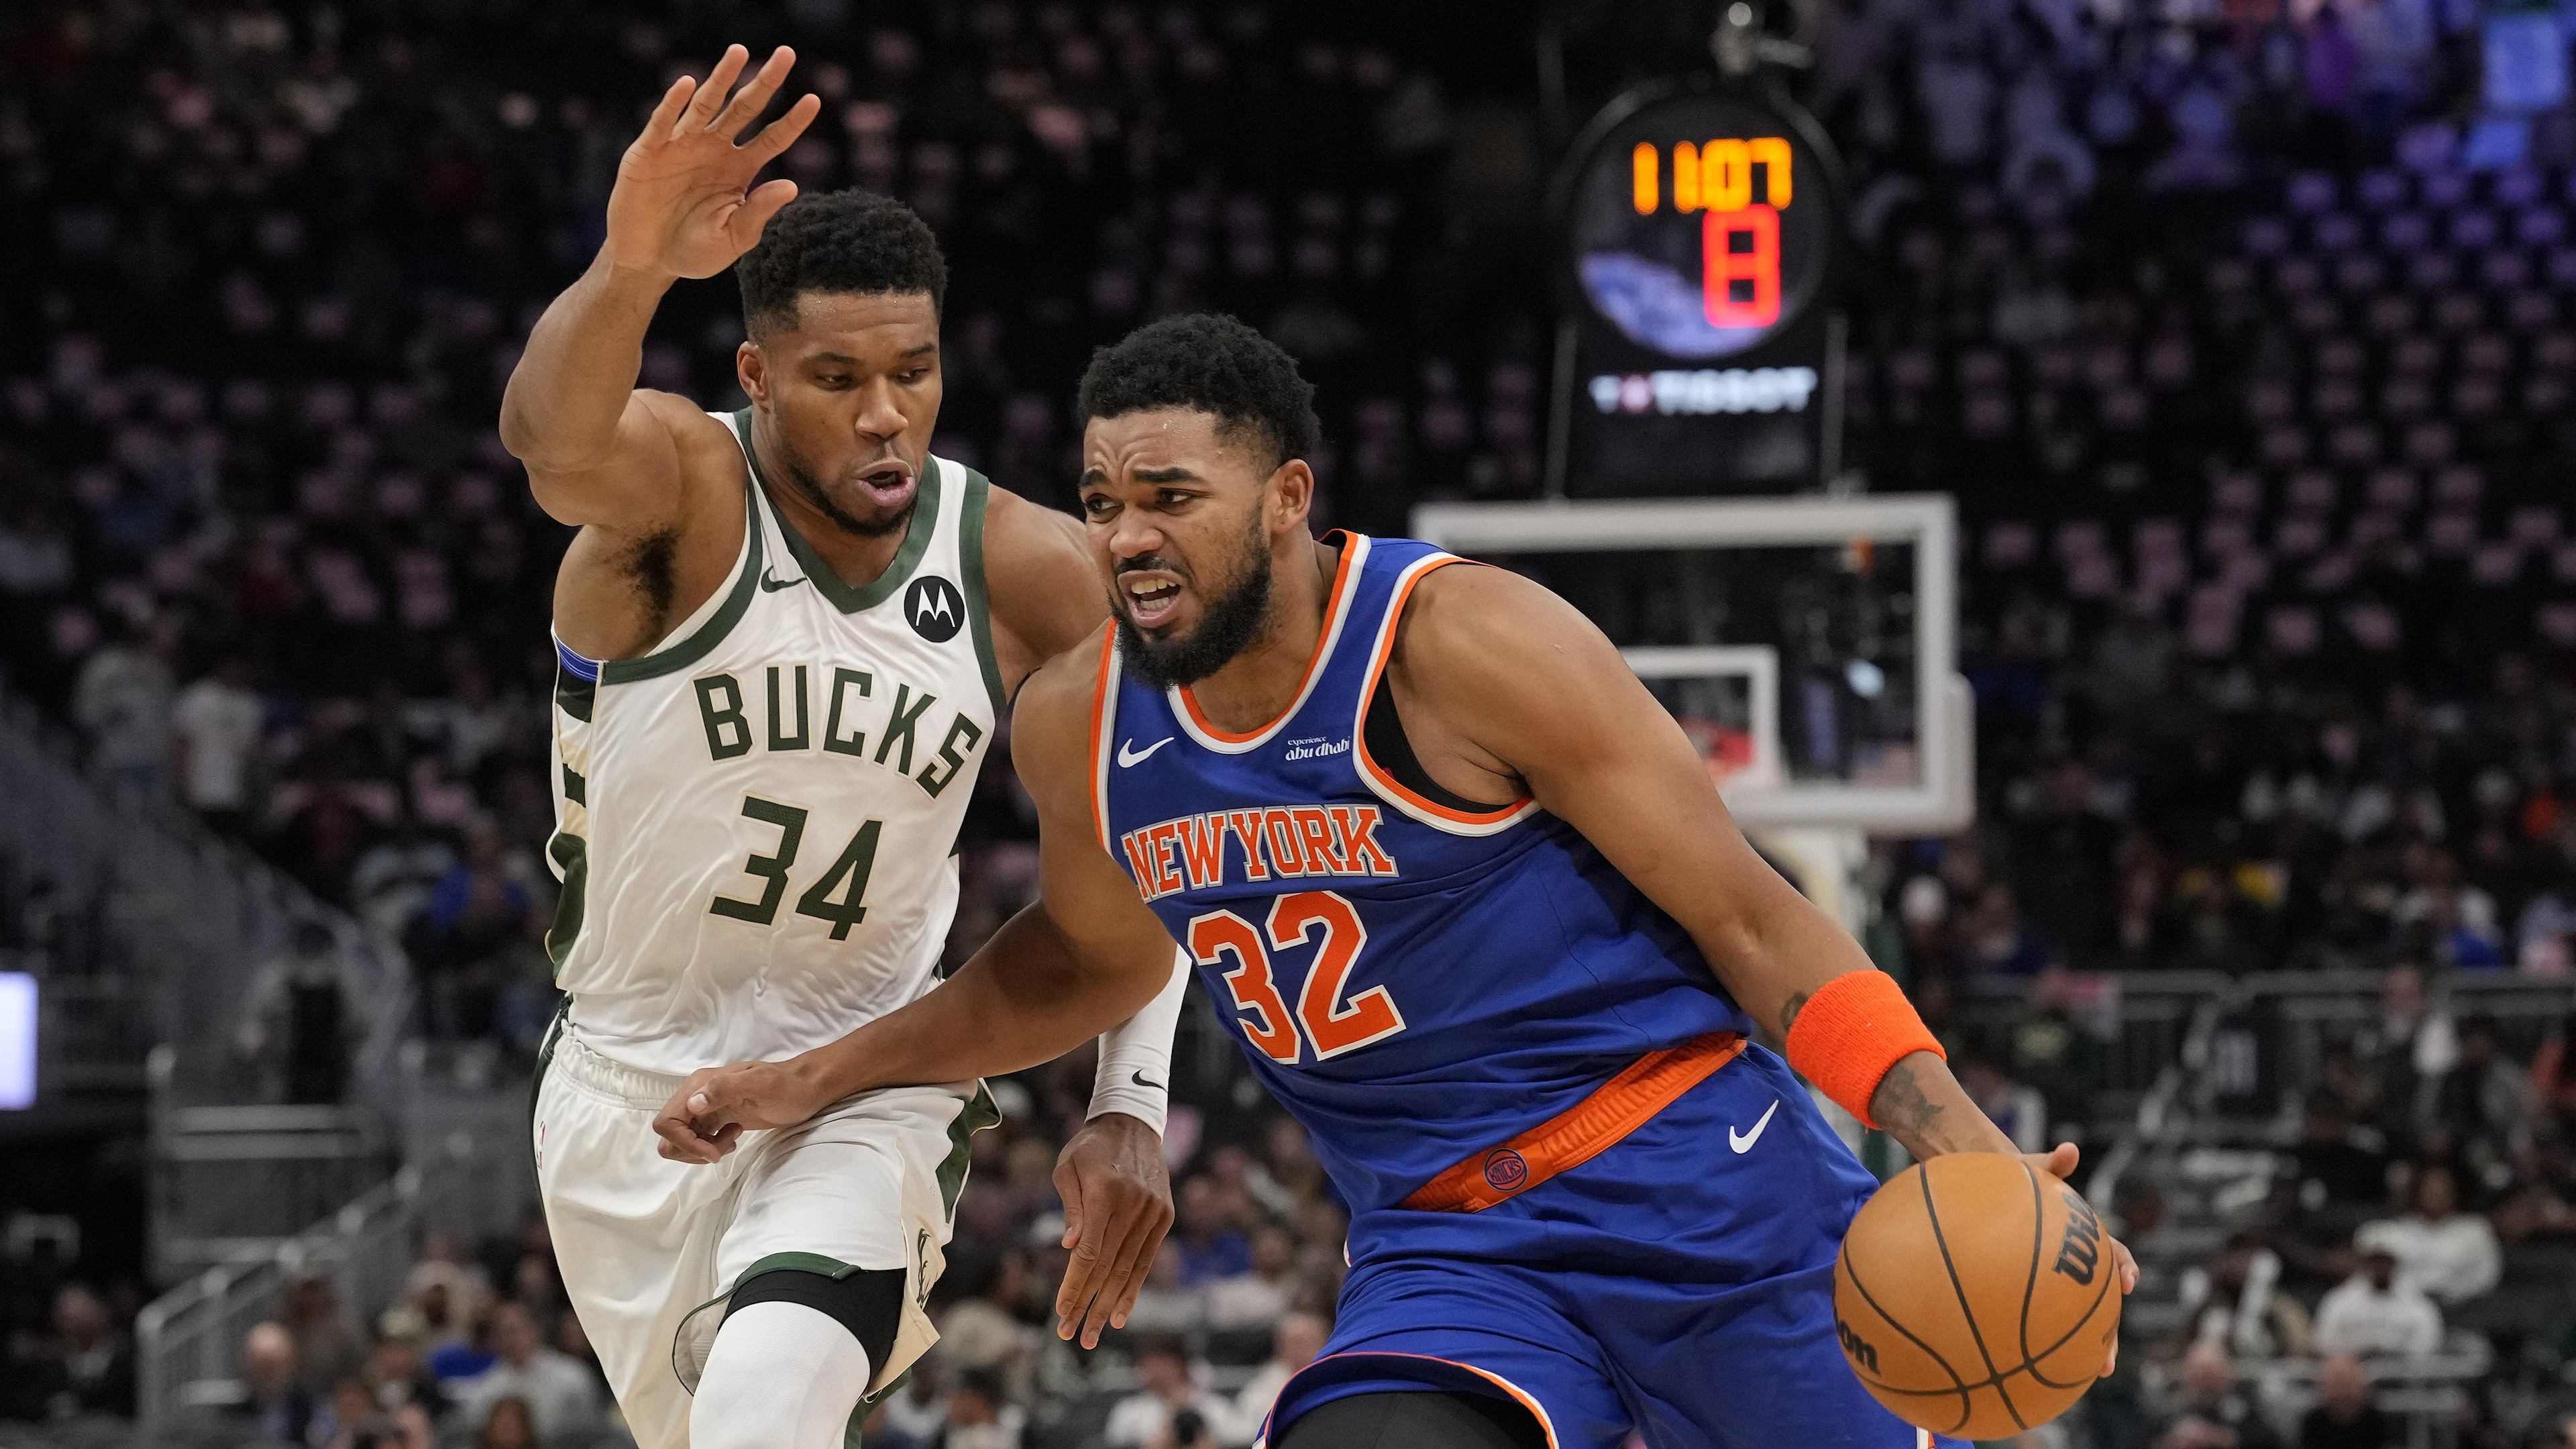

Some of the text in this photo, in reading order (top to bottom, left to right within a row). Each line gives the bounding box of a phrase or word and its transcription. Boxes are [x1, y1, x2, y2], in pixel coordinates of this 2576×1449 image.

[1703, 203, 1781, 329] 8
[692, 664, 983, 800] BUCKS
[1285, 736, 1350, 761] abu dhabi
[1287, 736, 1326, 746] experience
[708, 794, 883, 941] 34
[1120, 804, 1399, 904] NEW YORK
[1187, 890, 1406, 1065] 32
